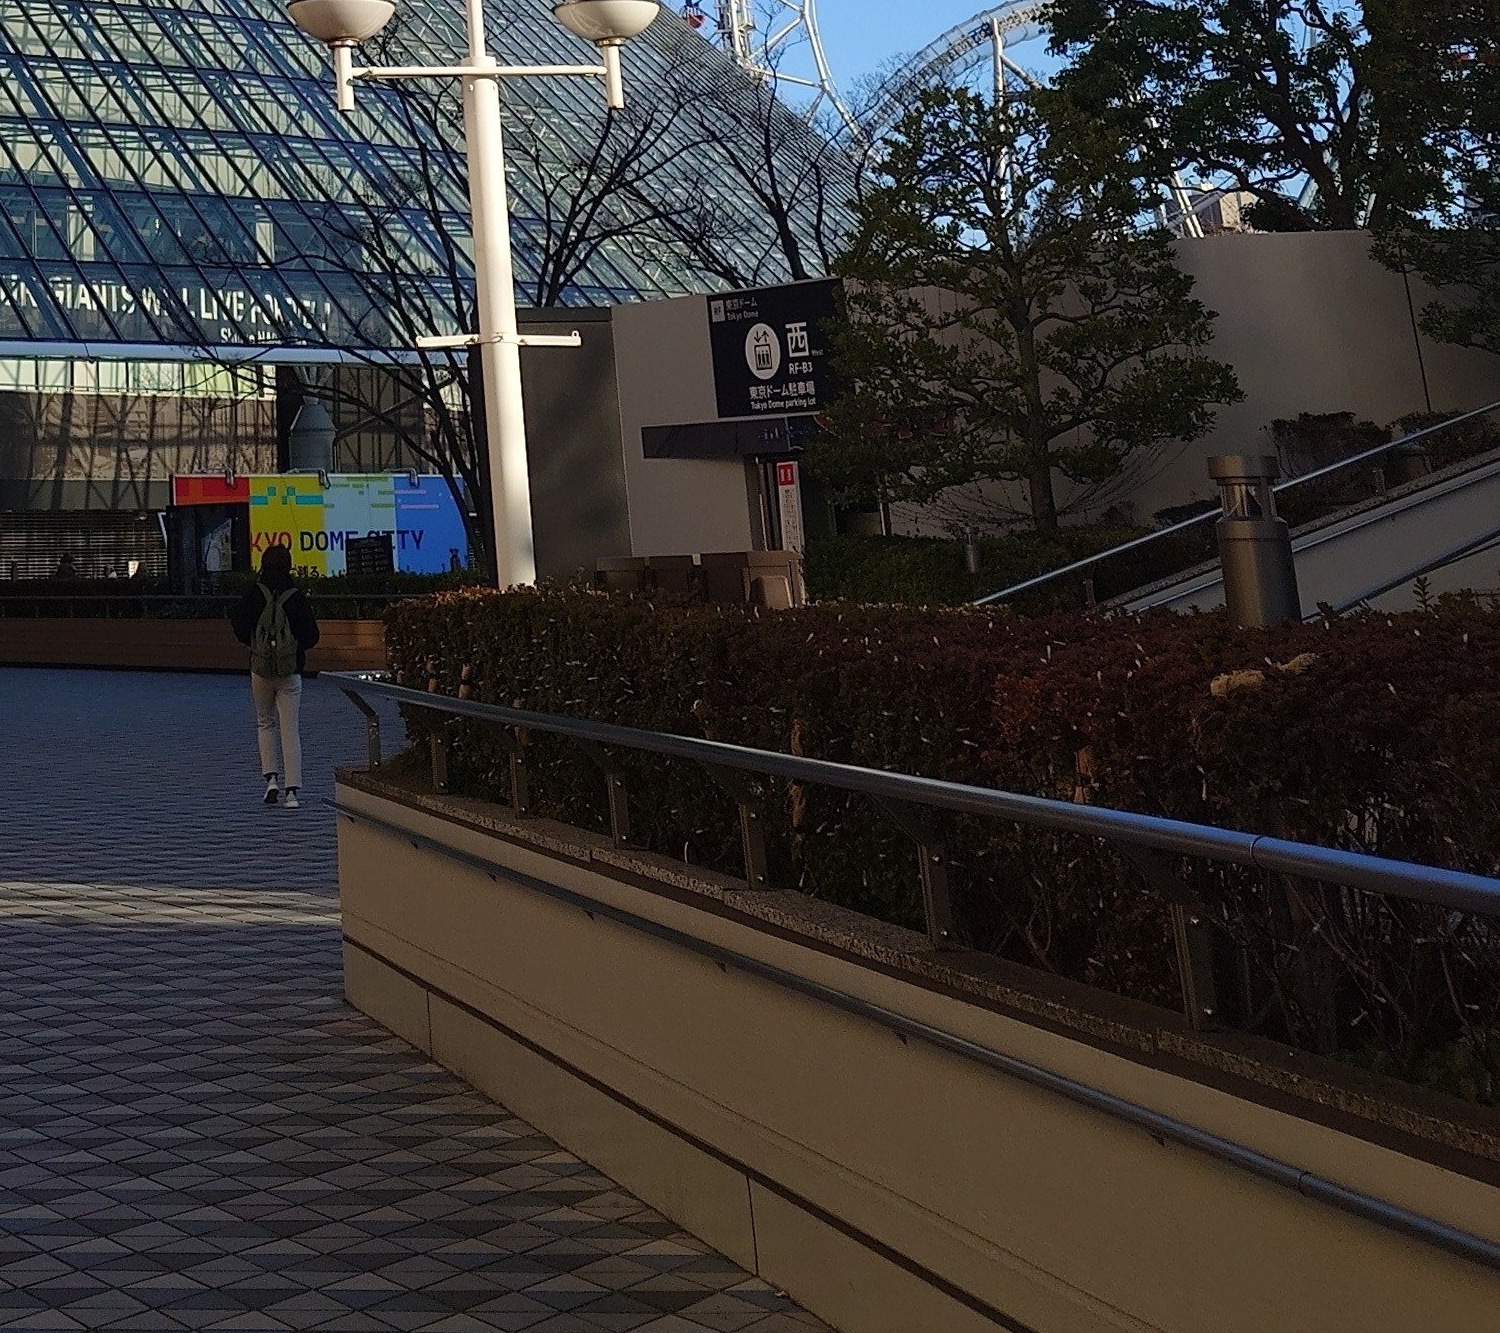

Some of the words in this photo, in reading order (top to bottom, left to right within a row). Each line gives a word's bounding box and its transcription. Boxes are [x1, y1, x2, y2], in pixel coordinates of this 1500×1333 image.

[48, 276, 136, 315] GIANTS
[200, 287, 244, 323] LIVE
[727, 312, 743, 321] Tokyo
[743, 310, 759, 319] Dome
[785, 321, 810, 358] 西
[788, 361, 813, 375] RF-B3
[749, 380, 815, 400] 東京ドーム駐車場
[750, 400, 768, 411] Tokyo
[768, 399, 784, 409] Dome
[785, 397, 807, 409] parking
